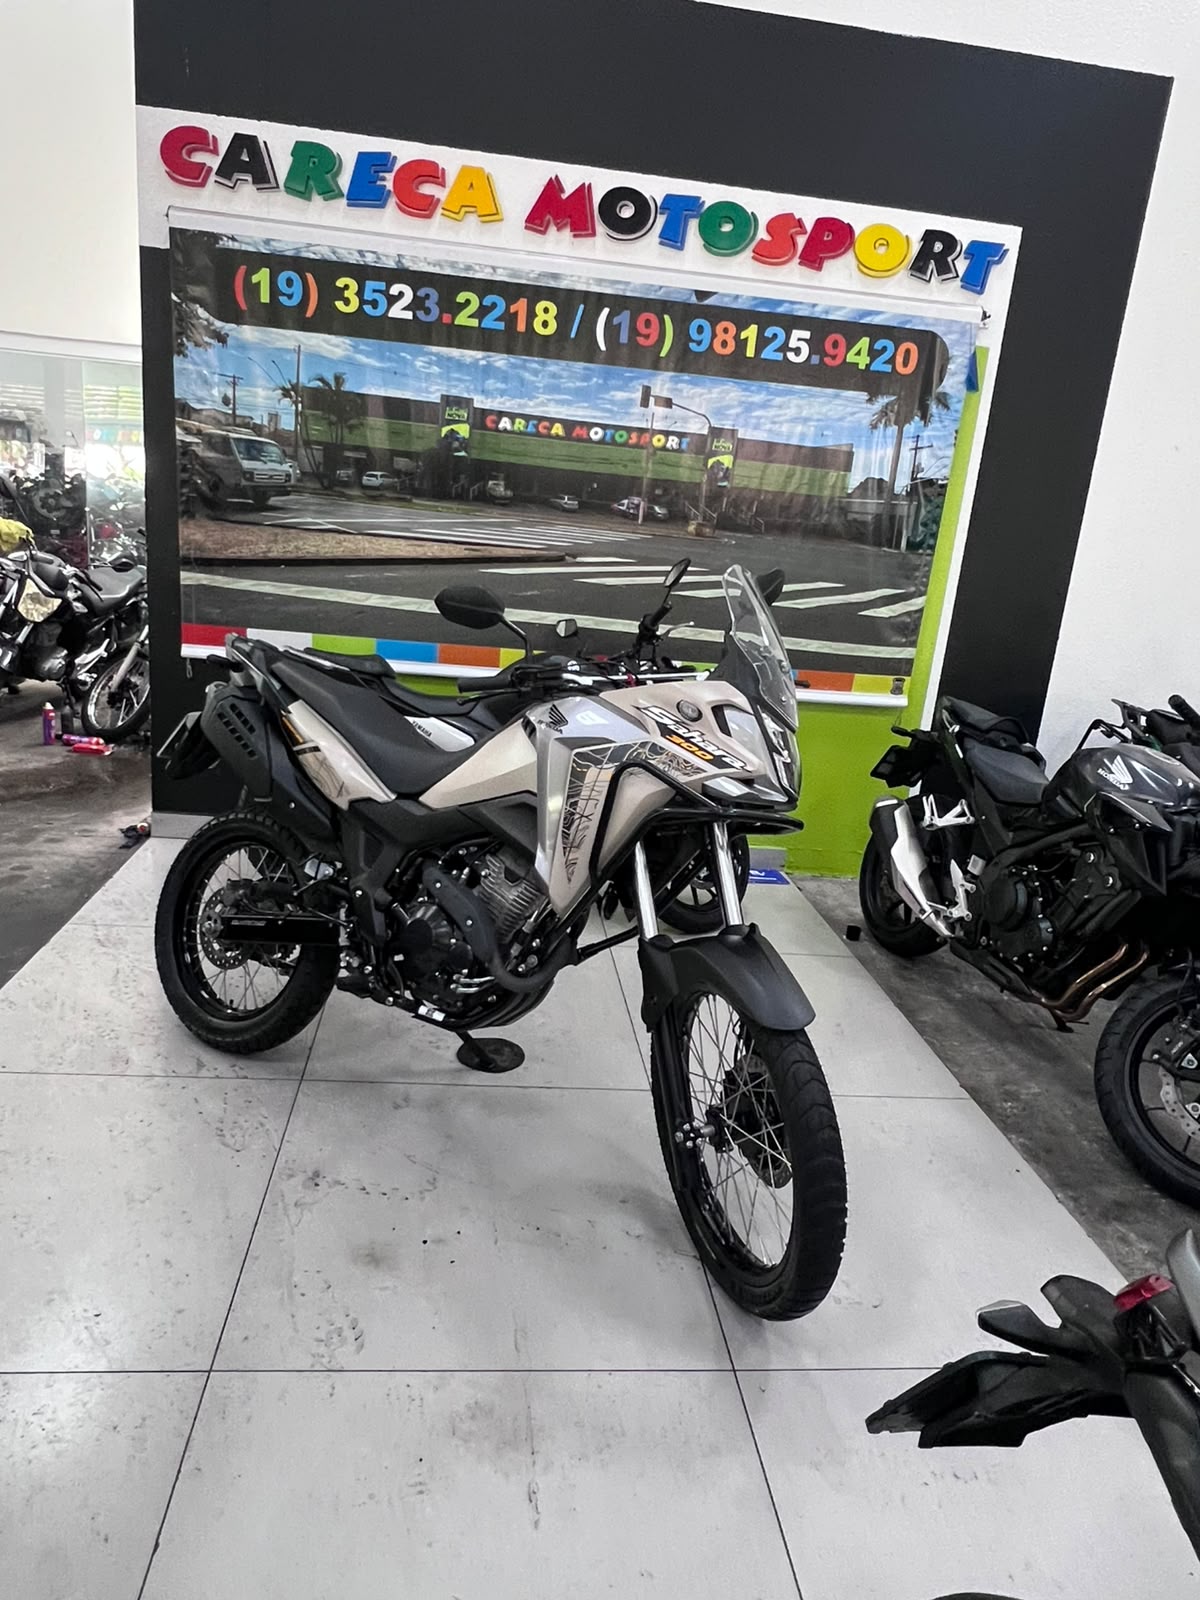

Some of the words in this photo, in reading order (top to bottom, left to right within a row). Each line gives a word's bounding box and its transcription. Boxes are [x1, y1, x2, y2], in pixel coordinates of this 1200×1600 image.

[160, 125, 504, 223] CARECA
[524, 174, 1009, 295] MOTOSPORT
[234, 265, 318, 318] (19)
[334, 276, 558, 336] 3523.2218
[596, 307, 673, 357] (19)
[688, 318, 919, 375] 98125.9420
[485, 414, 565, 438] CARECA
[665, 734, 714, 761] 300
